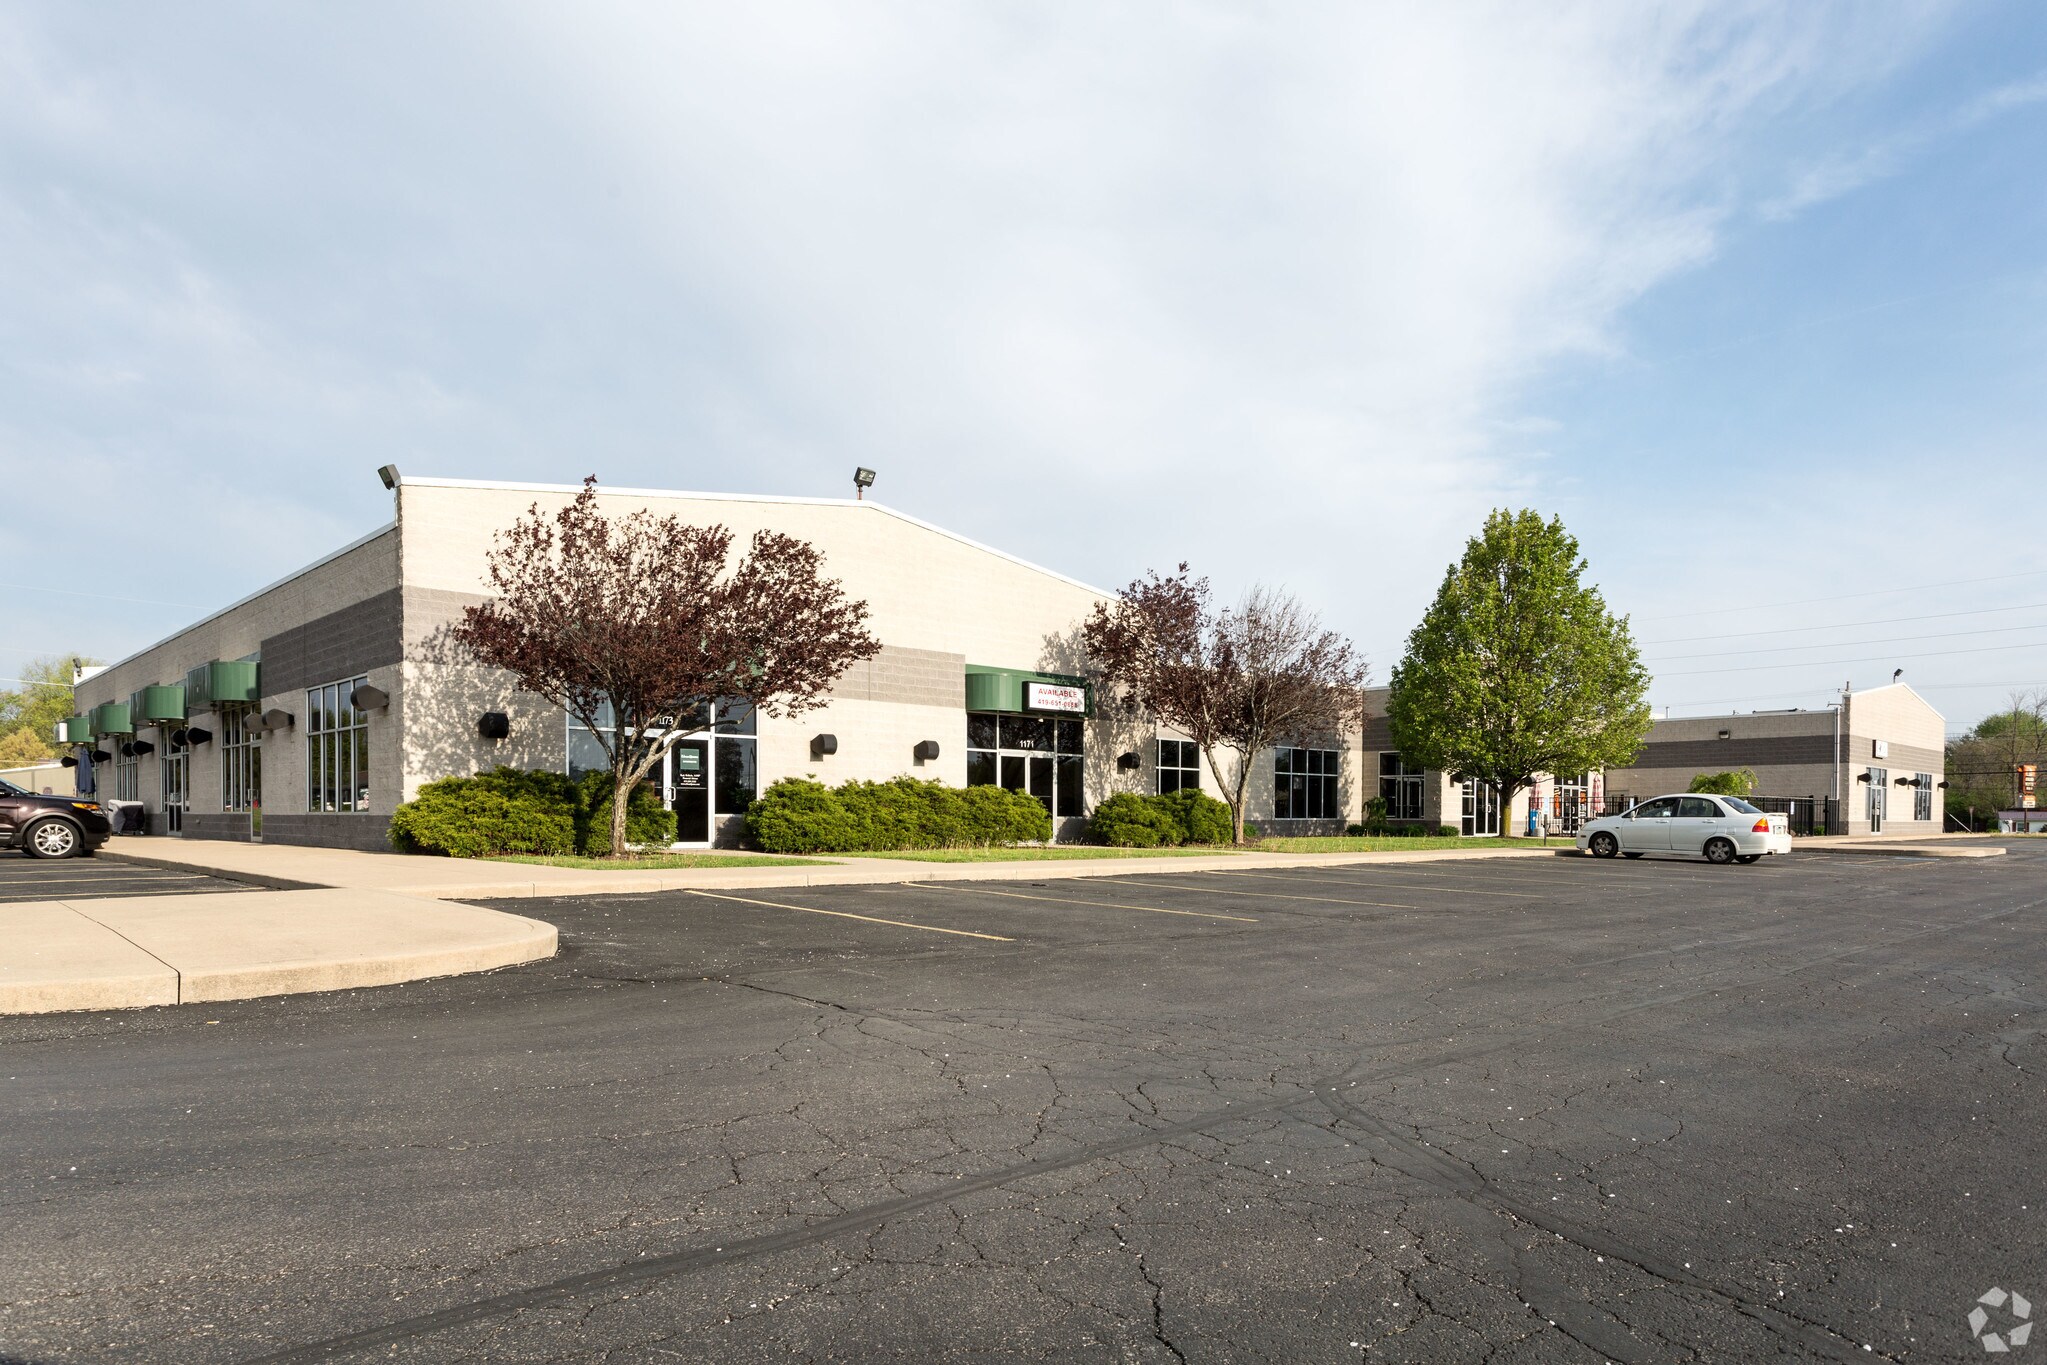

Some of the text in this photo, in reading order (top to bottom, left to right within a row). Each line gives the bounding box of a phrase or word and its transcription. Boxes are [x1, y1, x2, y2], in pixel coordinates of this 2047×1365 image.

[1038, 688, 1078, 698] AVAILABLE
[659, 715, 674, 725] 1173
[1020, 739, 1034, 748] 1171
